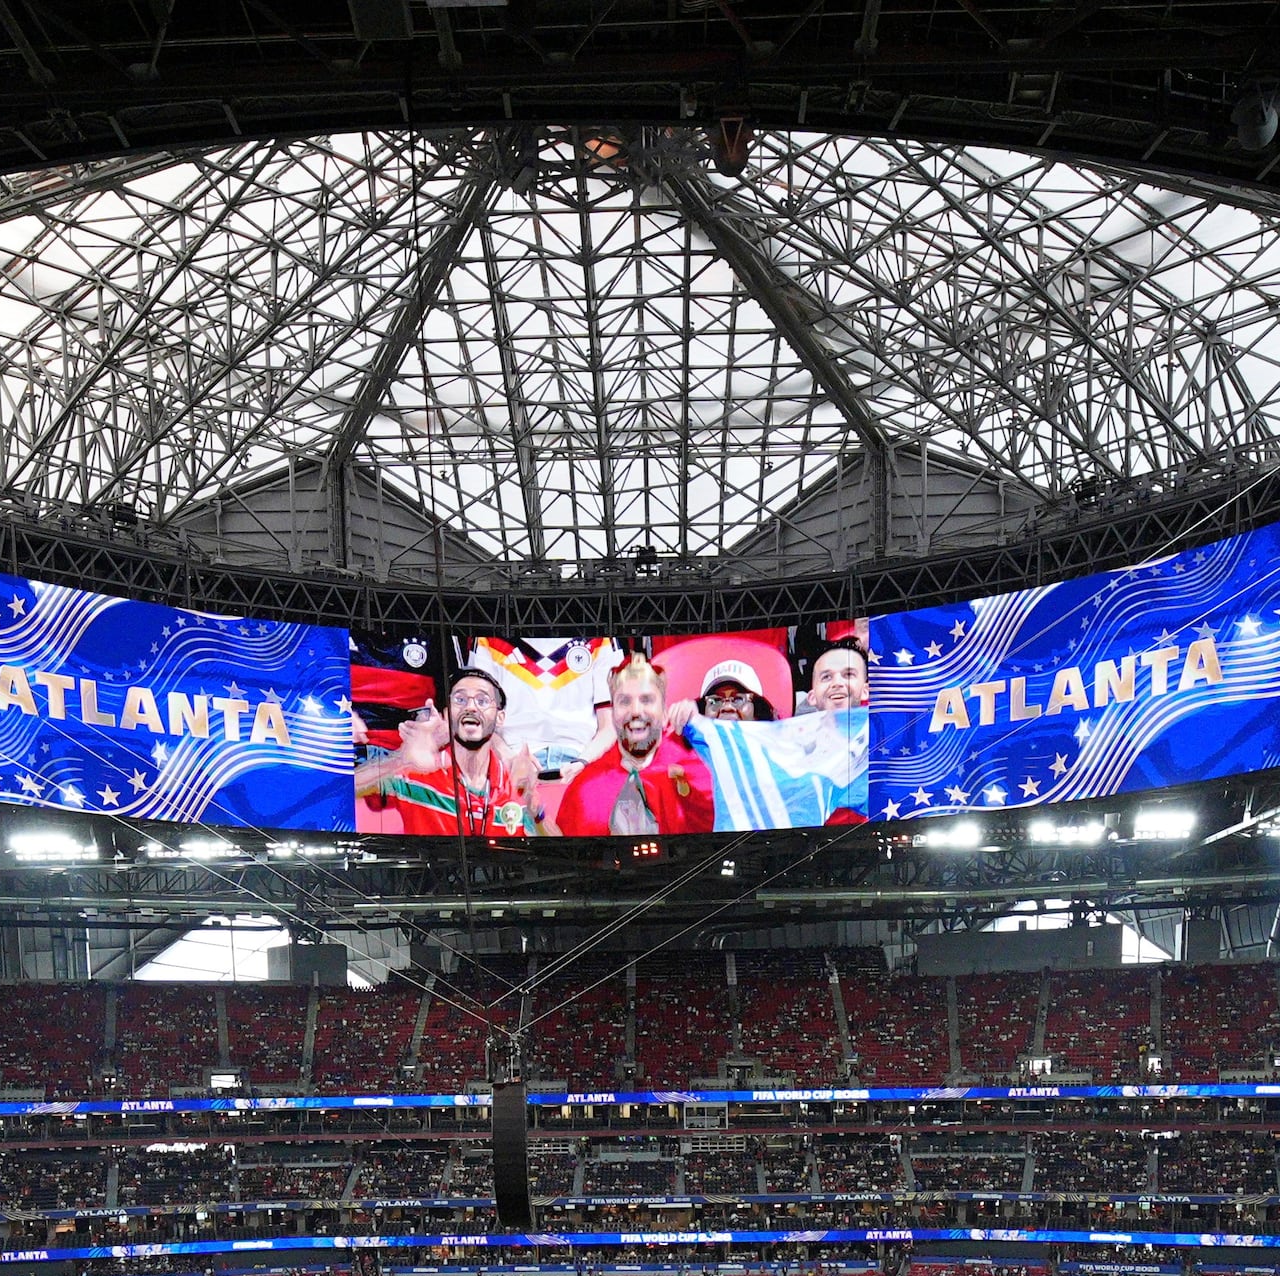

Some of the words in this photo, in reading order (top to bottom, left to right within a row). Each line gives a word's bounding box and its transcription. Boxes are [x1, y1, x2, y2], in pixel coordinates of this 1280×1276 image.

[927, 636, 1225, 735] ATLANTA
[752, 1091, 776, 1101] FIFA
[777, 1090, 811, 1100] WORLD
[813, 1090, 833, 1100] CUP
[833, 1090, 869, 1099] 2026
[1007, 1087, 1060, 1097] ATLANTA
[567, 1093, 616, 1102] ATLANTA
[121, 1100, 174, 1111] ATLANTA
[1138, 1195, 1190, 1203] ATLANTA
[75, 1209, 128, 1217] ATLANTA
[621, 1234, 642, 1243] FIFA
[643, 1233, 674, 1243] WORLD
[677, 1233, 697, 1242] CUP
[865, 1231, 913, 1240] ATLANTA
[441, 1237, 488, 1245] ATLANTA
[1079, 1264, 1095, 1272] FIFA
